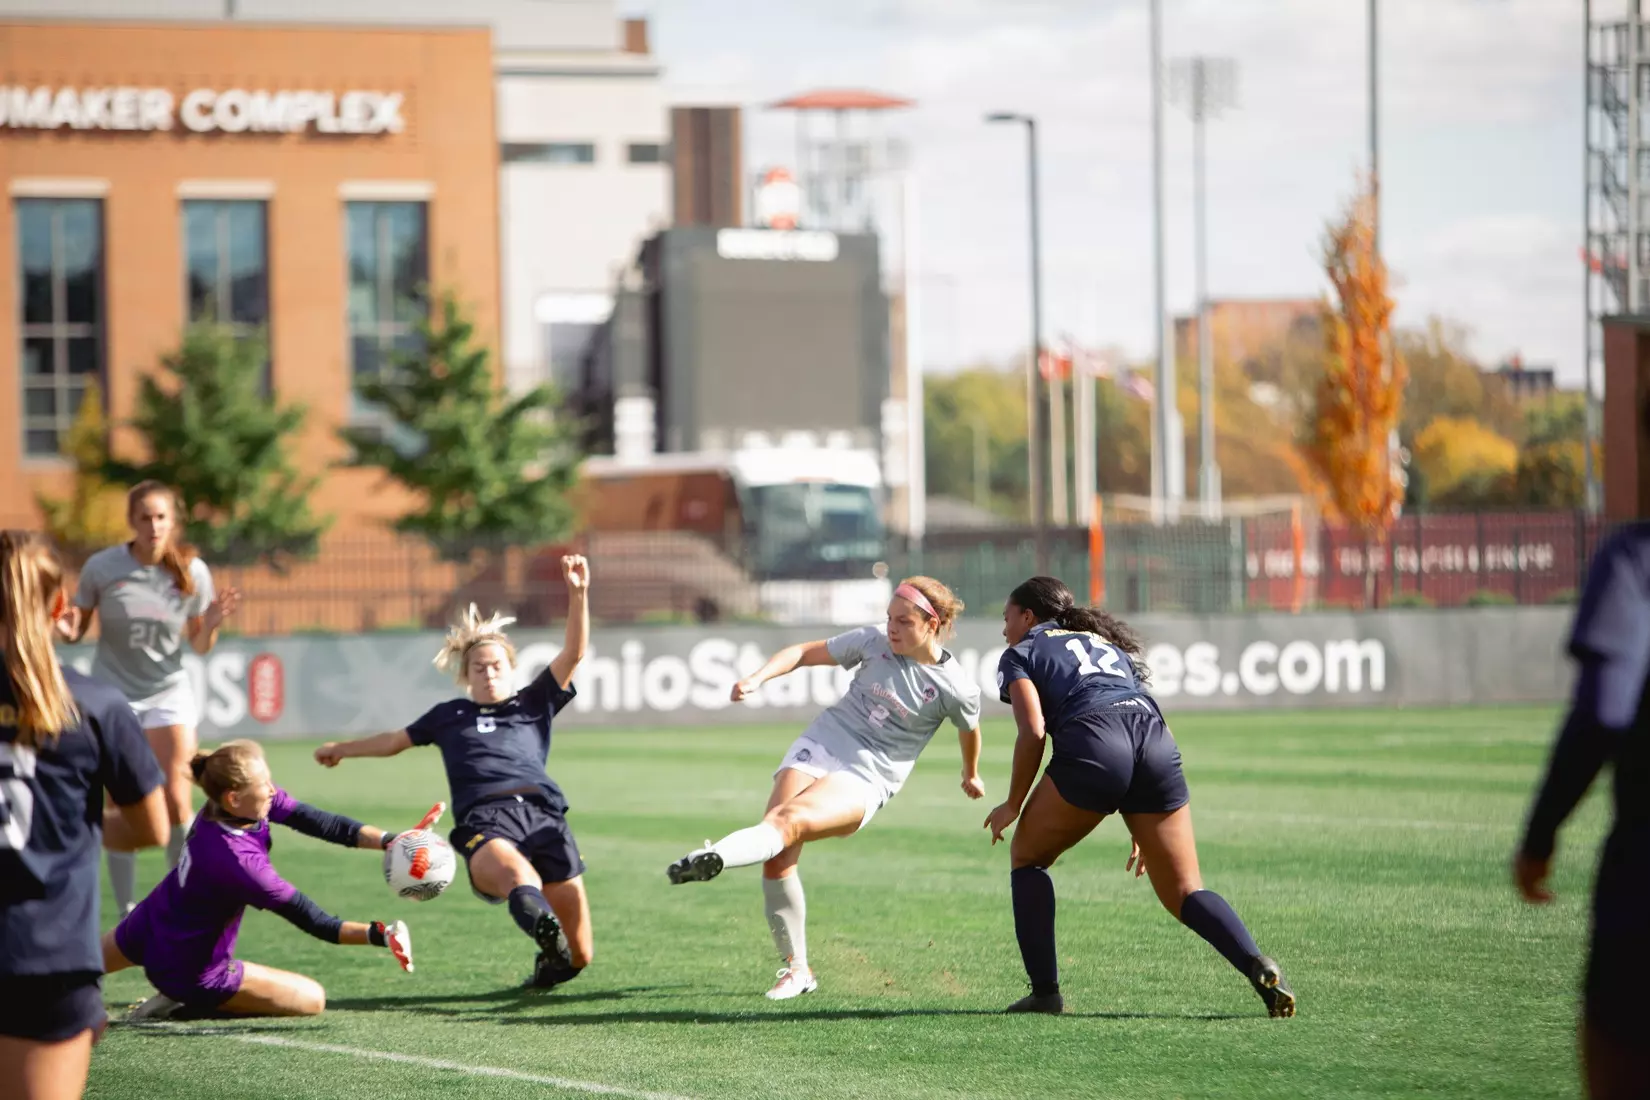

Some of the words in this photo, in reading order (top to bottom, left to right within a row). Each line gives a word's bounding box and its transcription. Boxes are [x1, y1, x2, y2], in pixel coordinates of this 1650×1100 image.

[180, 88, 404, 133] COMPLEX
[1065, 638, 1126, 678] 12
[869, 704, 890, 728] 2
